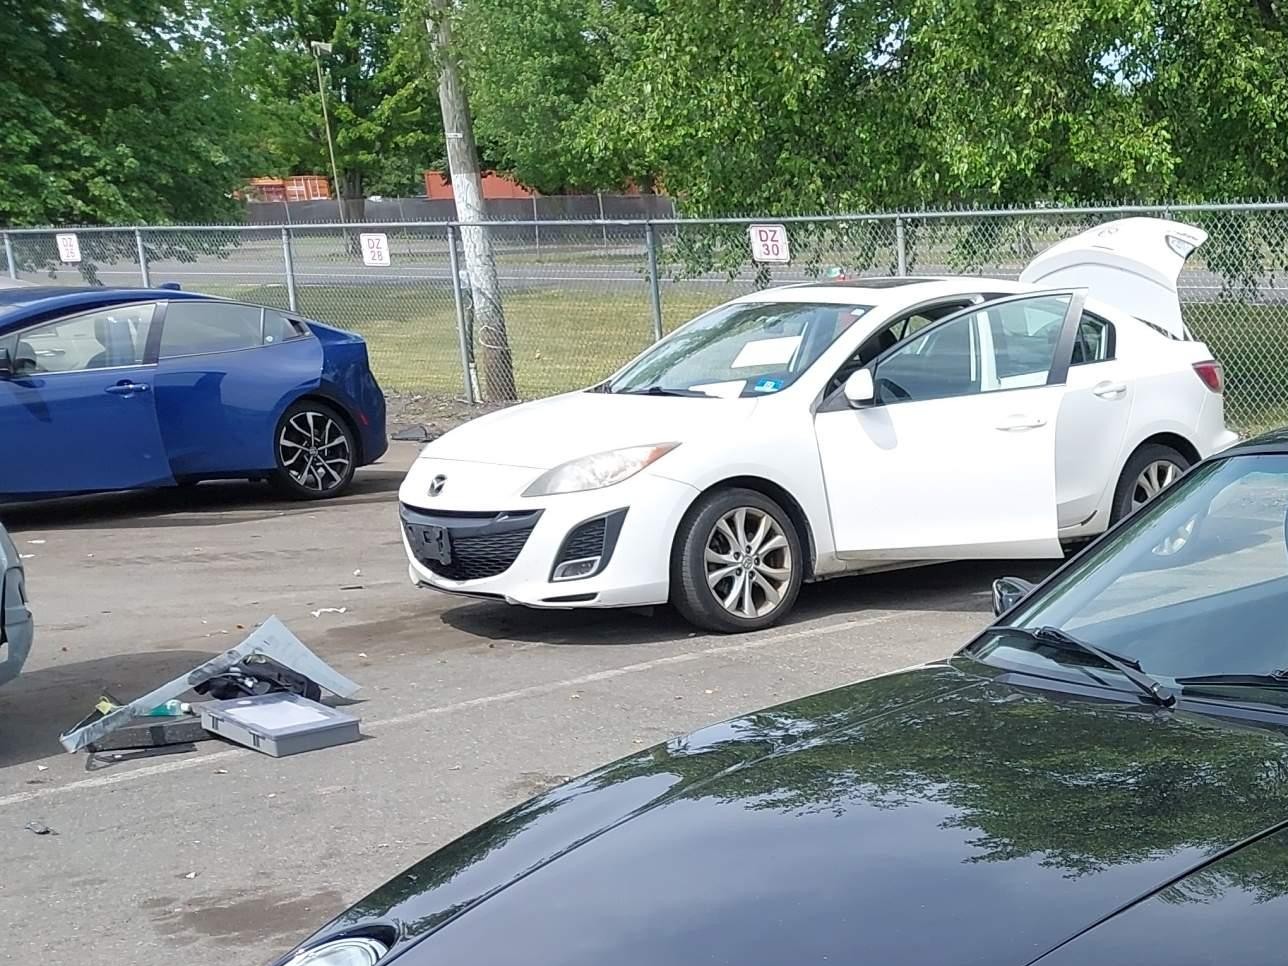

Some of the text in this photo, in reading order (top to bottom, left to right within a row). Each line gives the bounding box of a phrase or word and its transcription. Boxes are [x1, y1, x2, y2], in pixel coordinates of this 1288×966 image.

[758, 229, 779, 242] DZ
[367, 238, 382, 249] DZ
[762, 243, 780, 256] 30
[370, 250, 383, 261] 28
